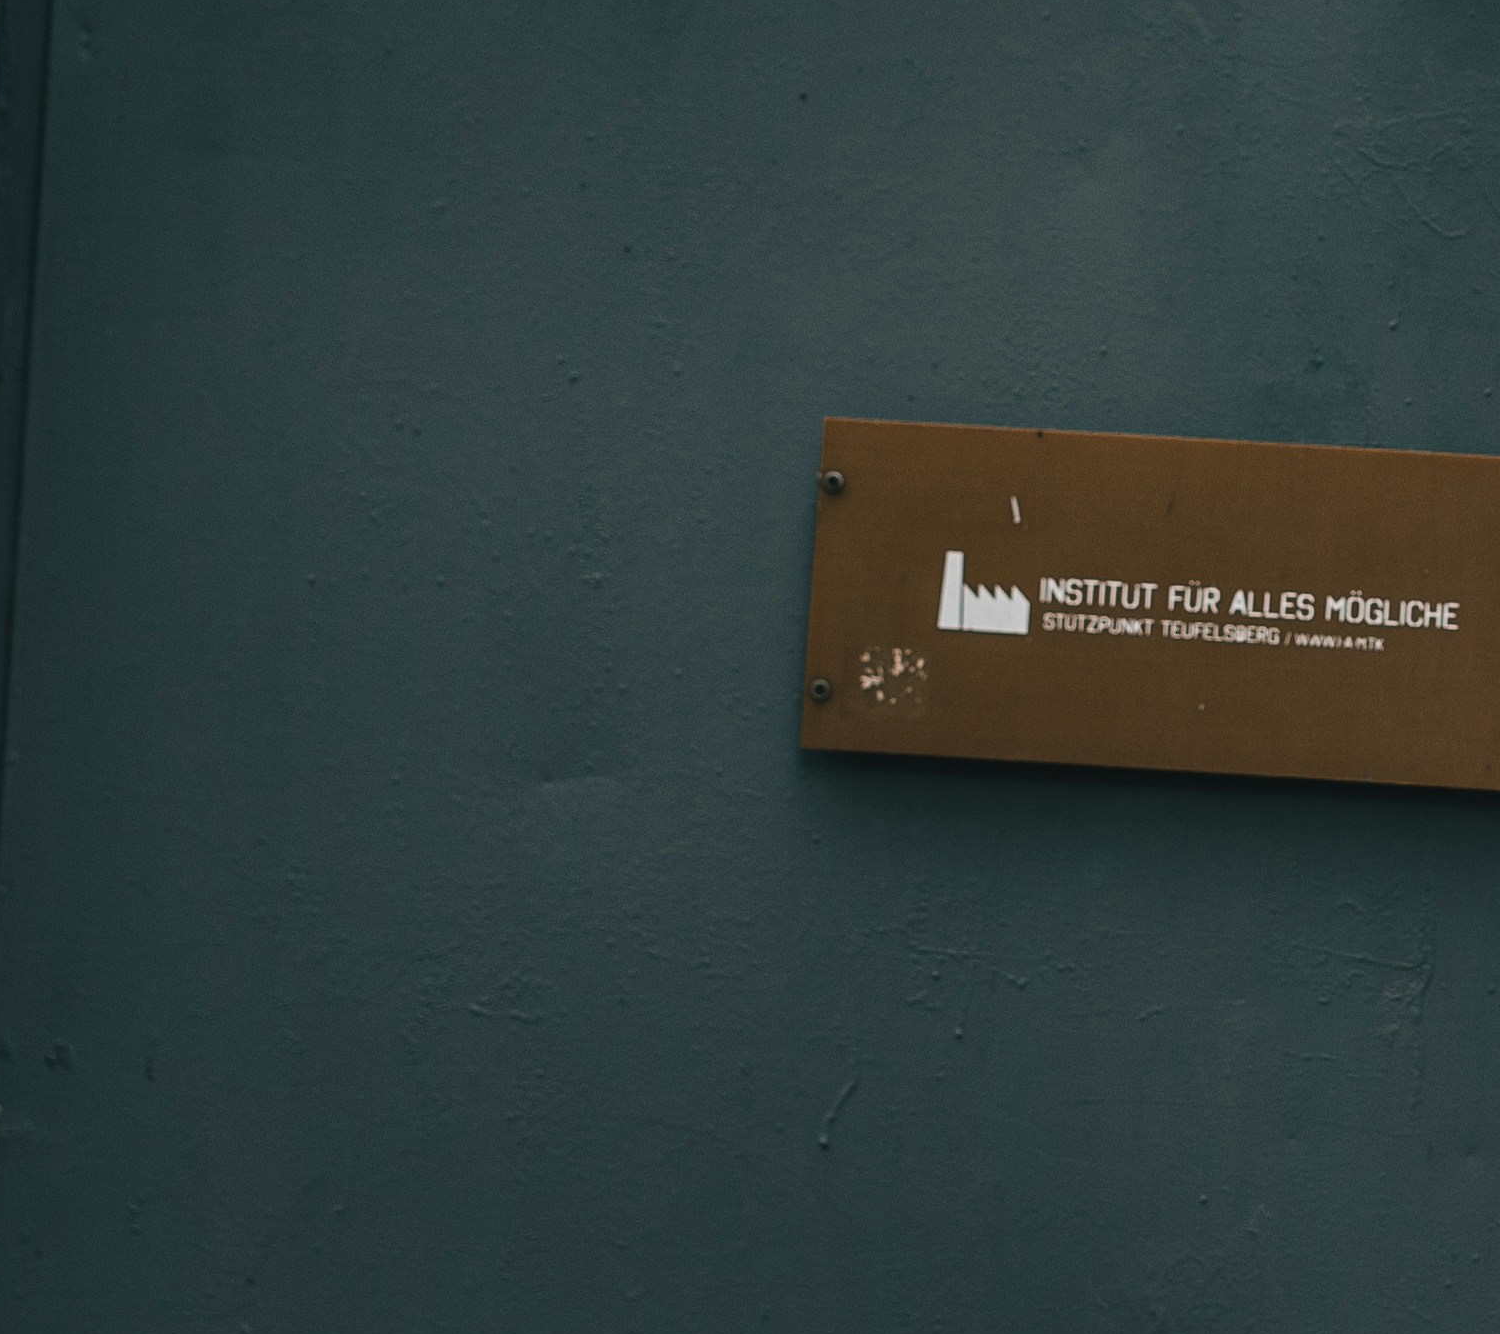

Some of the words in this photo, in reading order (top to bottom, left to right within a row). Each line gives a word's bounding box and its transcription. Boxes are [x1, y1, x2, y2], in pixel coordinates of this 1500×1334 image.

[1038, 576, 1158, 611] INSTITUT
[1167, 579, 1221, 614] FÜR
[1228, 589, 1315, 622] ALLES
[1324, 589, 1461, 631] MÖGLICHE
[1161, 618, 1281, 647] TEUFELSBERG
